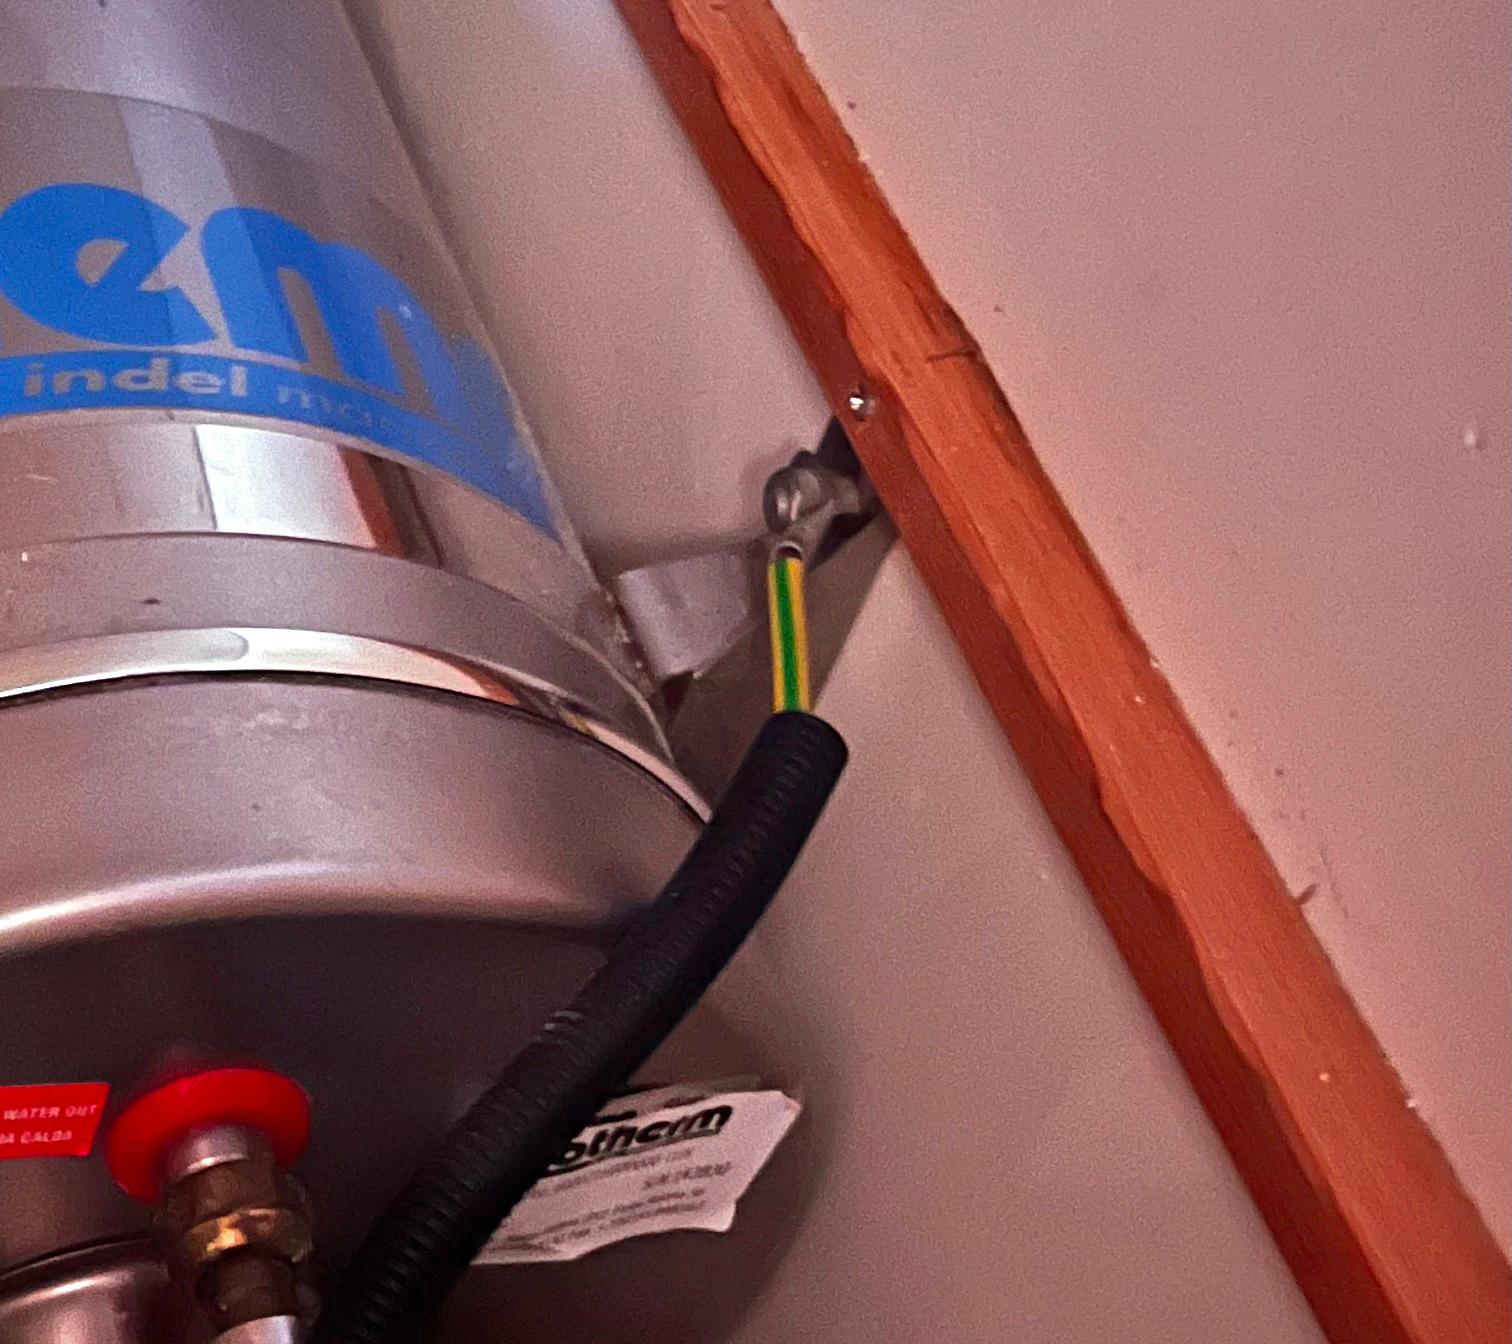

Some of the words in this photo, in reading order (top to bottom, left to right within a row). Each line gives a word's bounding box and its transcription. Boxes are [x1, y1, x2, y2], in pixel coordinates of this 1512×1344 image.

[22, 361, 247, 398] indel
[3, 1105, 61, 1121] WATER
[65, 1103, 98, 1118] OUT
[20, 1129, 73, 1145] CALDA
